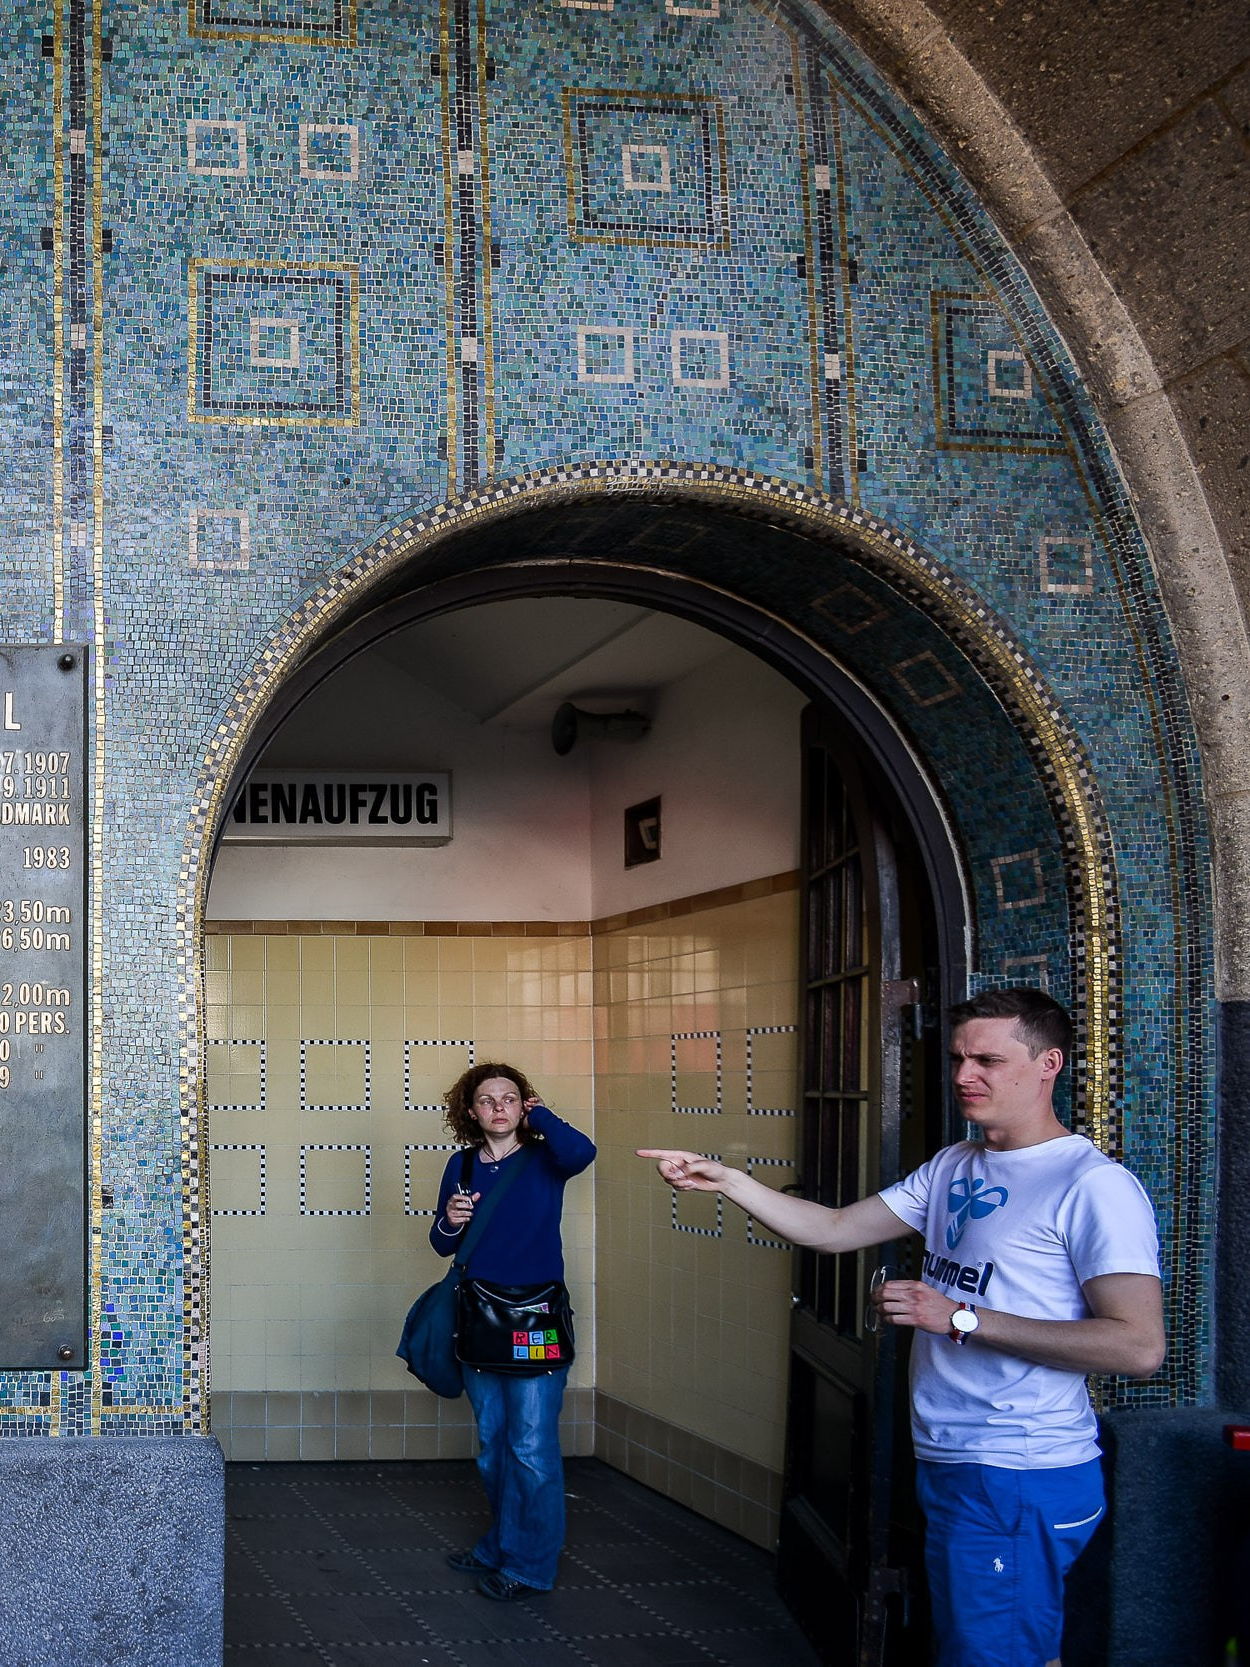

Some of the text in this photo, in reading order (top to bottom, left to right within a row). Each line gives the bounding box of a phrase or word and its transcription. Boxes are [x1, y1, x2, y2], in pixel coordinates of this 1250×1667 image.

[22, 846, 70, 869] 1983
[14, 1011, 70, 1035] PERS.
[516, 1331, 556, 1344] BER
[516, 1346, 559, 1358] LIN
